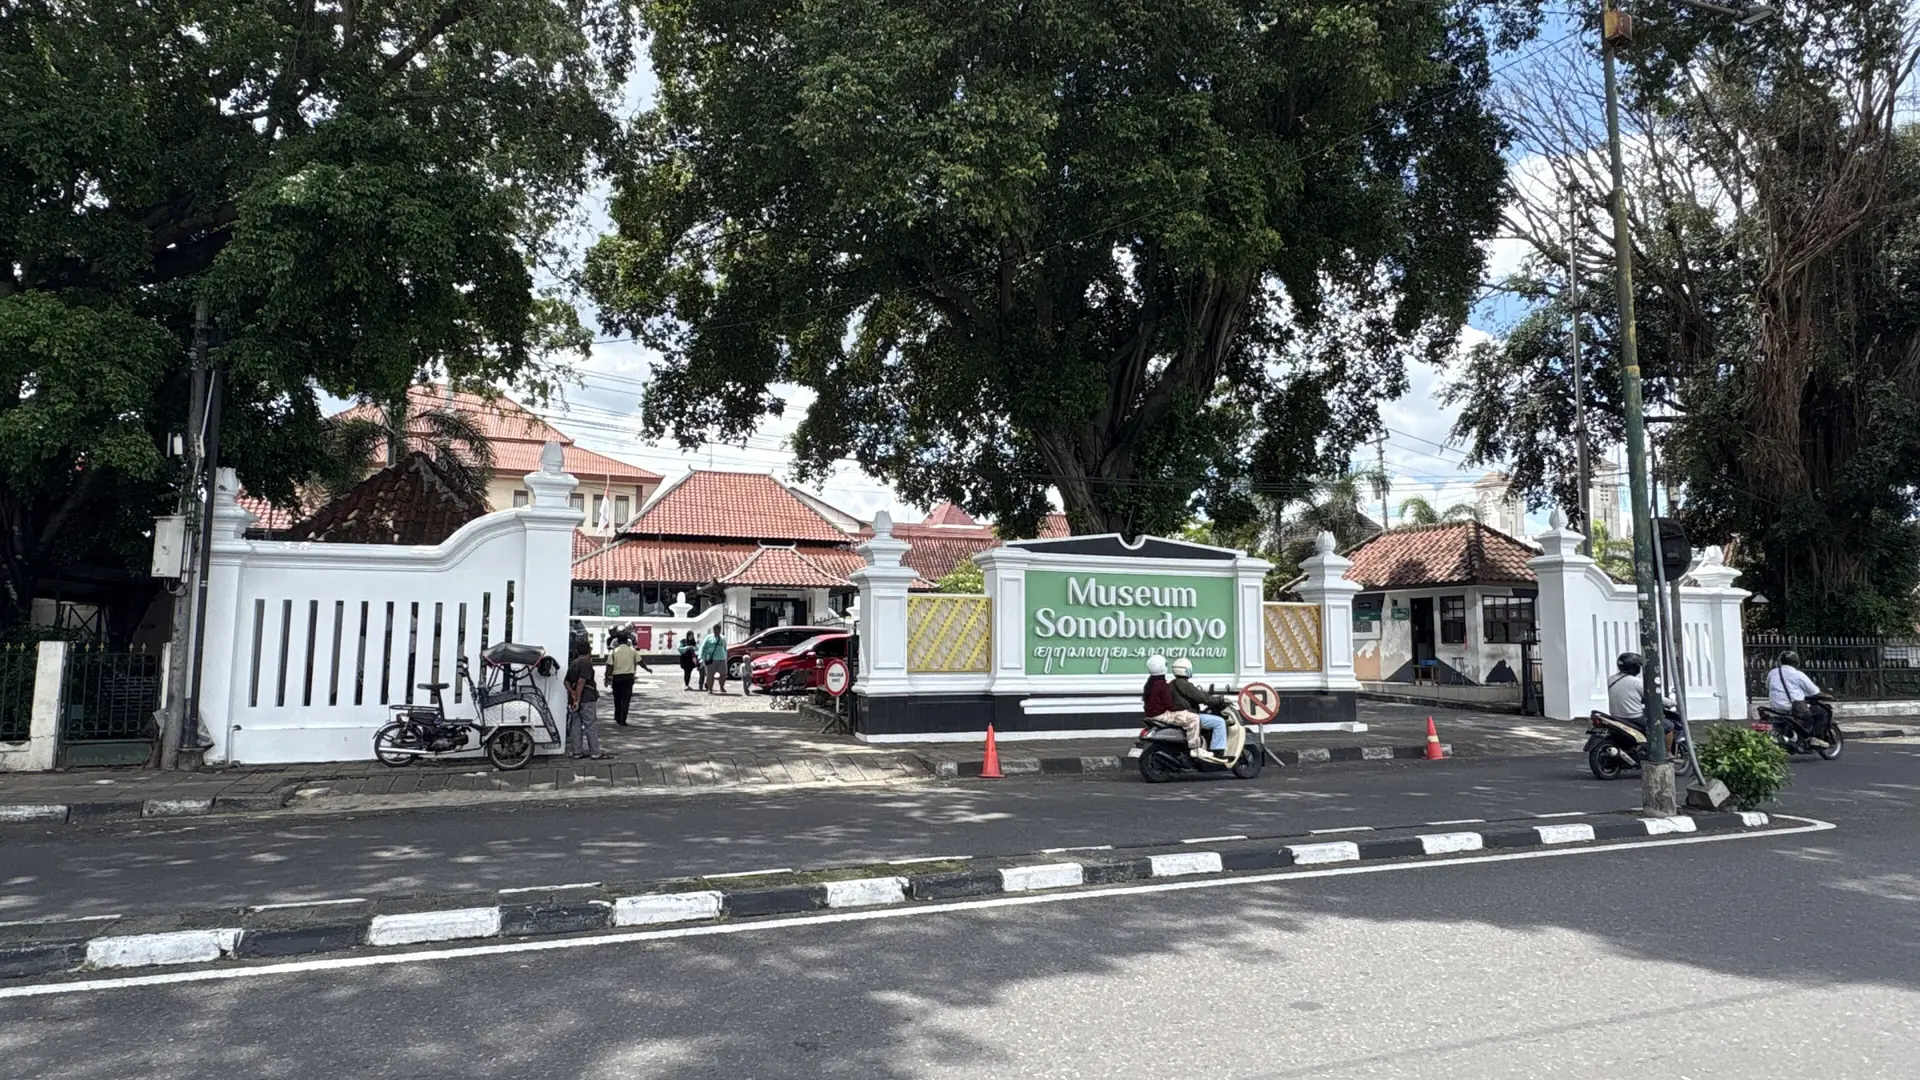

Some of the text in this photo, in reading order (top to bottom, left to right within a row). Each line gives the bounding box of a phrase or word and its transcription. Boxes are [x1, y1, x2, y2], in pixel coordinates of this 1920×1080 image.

[1067, 576, 1198, 608] Museum
[1034, 608, 1227, 646] Sonobudoyo
[1249, 689, 1268, 716] P
